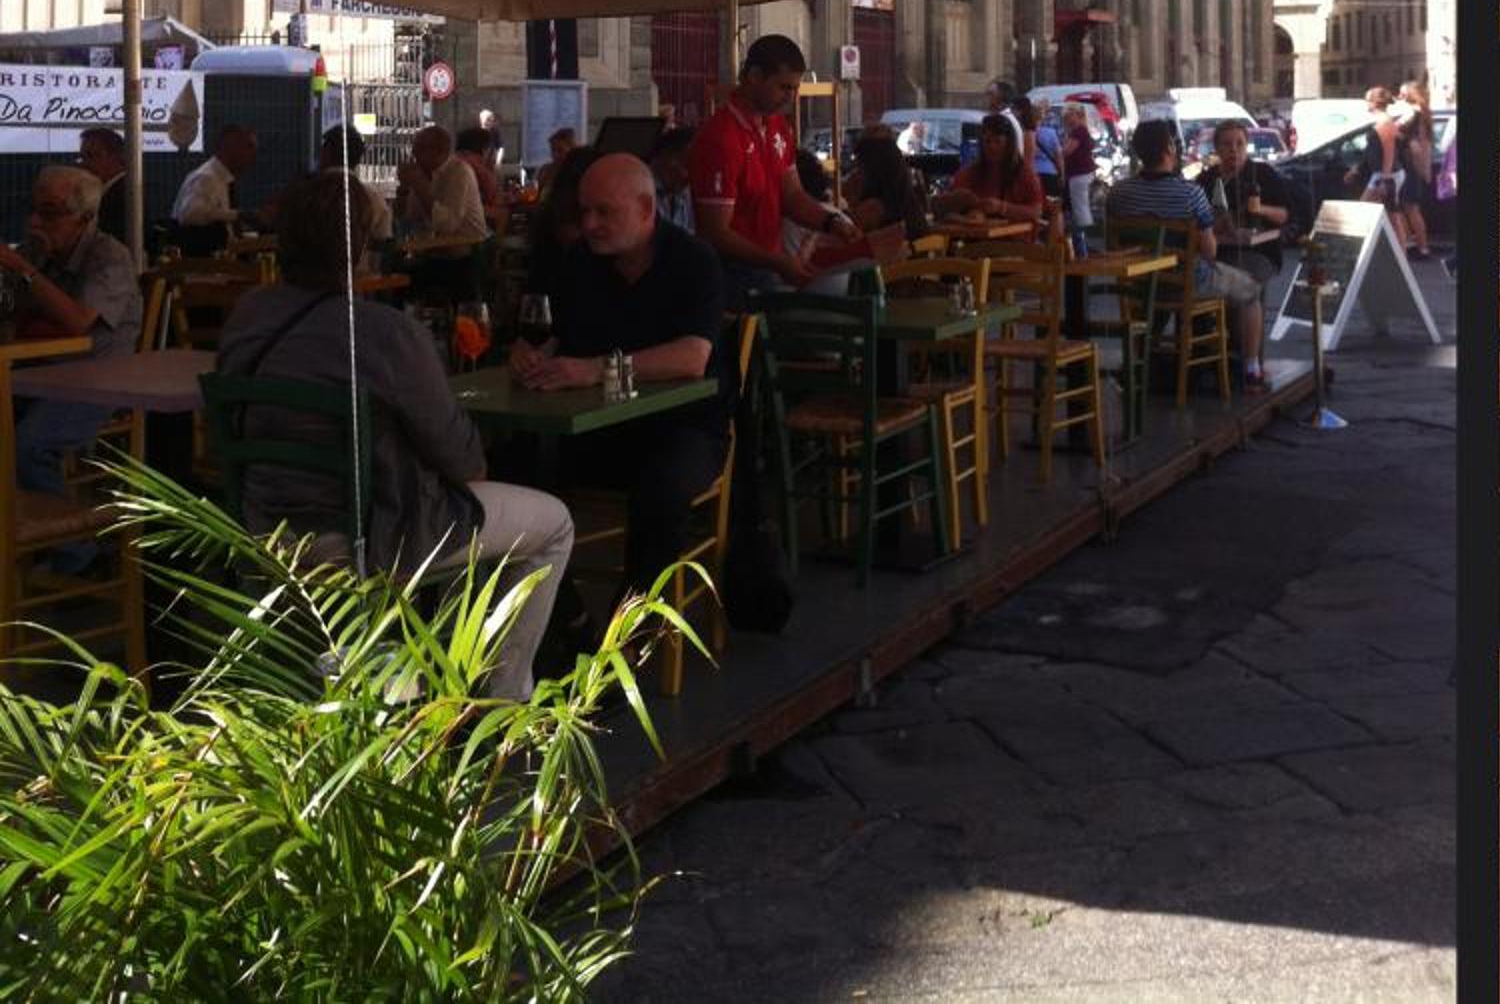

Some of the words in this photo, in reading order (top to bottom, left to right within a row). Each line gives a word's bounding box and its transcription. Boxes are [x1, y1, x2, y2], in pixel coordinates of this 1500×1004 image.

[0, 73, 168, 90] RISTORATE
[0, 93, 32, 123] Da
[43, 96, 168, 120] Pinoccio
